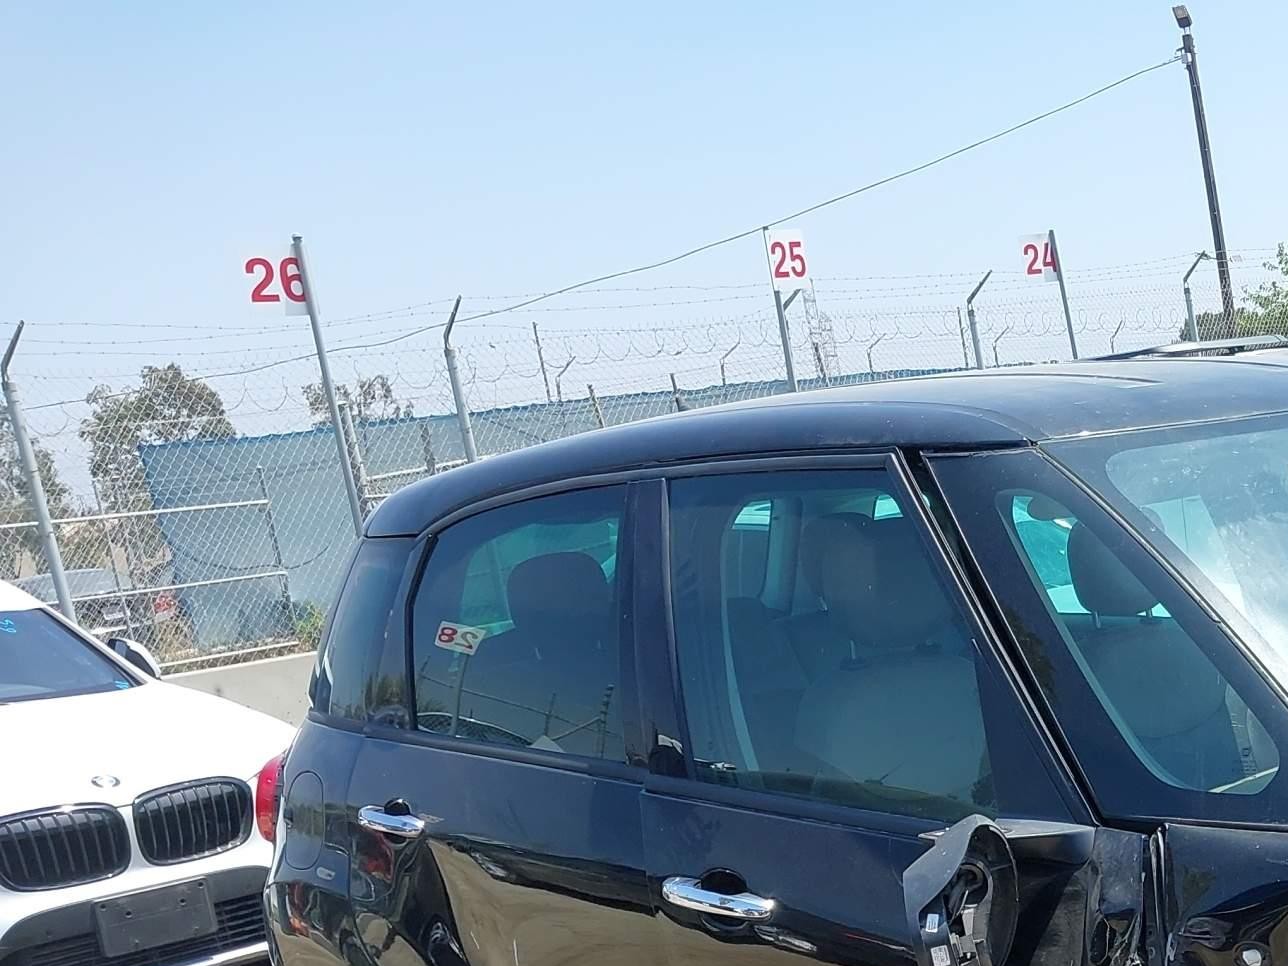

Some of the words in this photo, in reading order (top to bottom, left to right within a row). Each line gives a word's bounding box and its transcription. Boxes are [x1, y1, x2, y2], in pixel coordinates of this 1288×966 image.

[770, 241, 806, 278] 25
[1023, 242, 1058, 275] 24
[244, 257, 307, 302] 26
